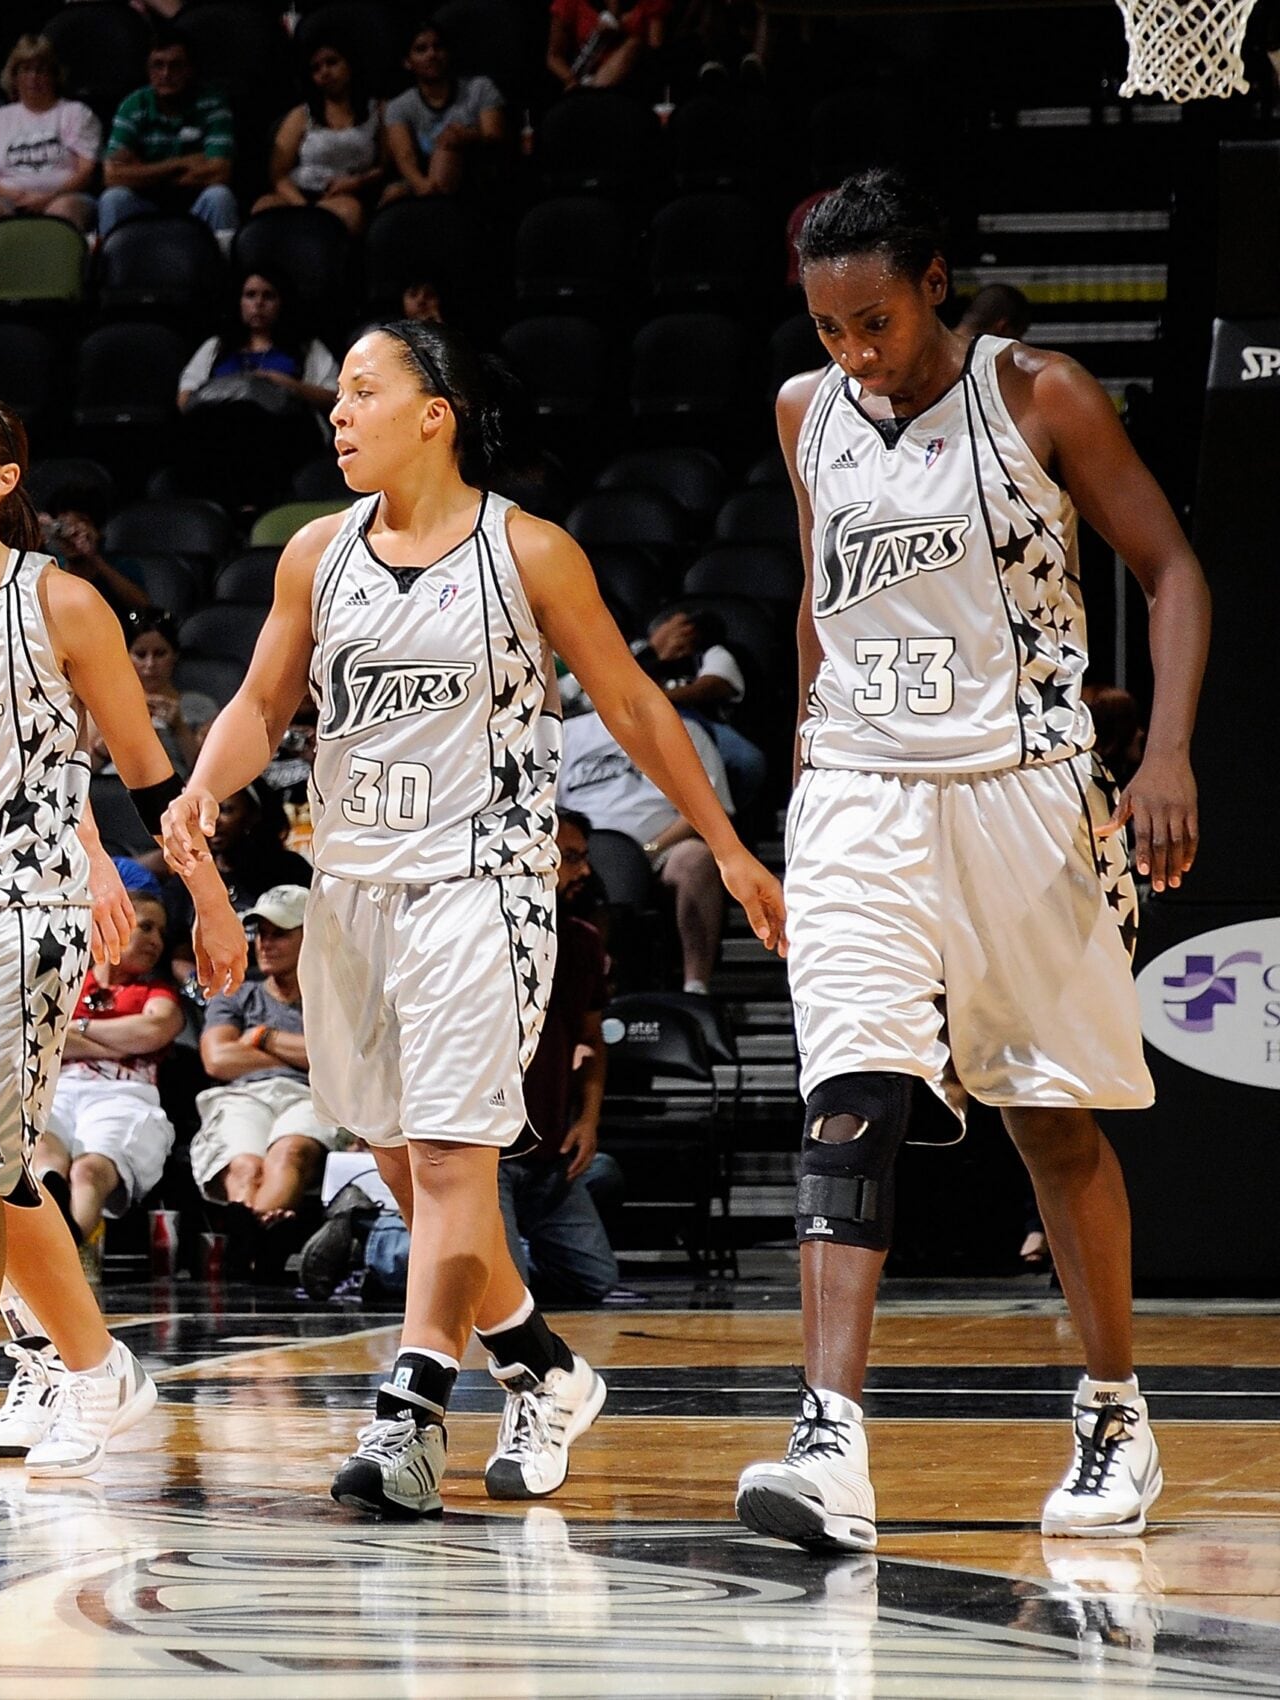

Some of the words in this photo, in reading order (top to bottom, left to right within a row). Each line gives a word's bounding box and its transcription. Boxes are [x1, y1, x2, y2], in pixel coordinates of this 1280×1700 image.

[830, 461, 858, 470] adidas
[814, 502, 970, 619] STARS
[320, 638, 476, 740] STARS
[853, 637, 956, 716] 33
[341, 754, 432, 832] 30
[1093, 1391, 1120, 1403] NIKE
